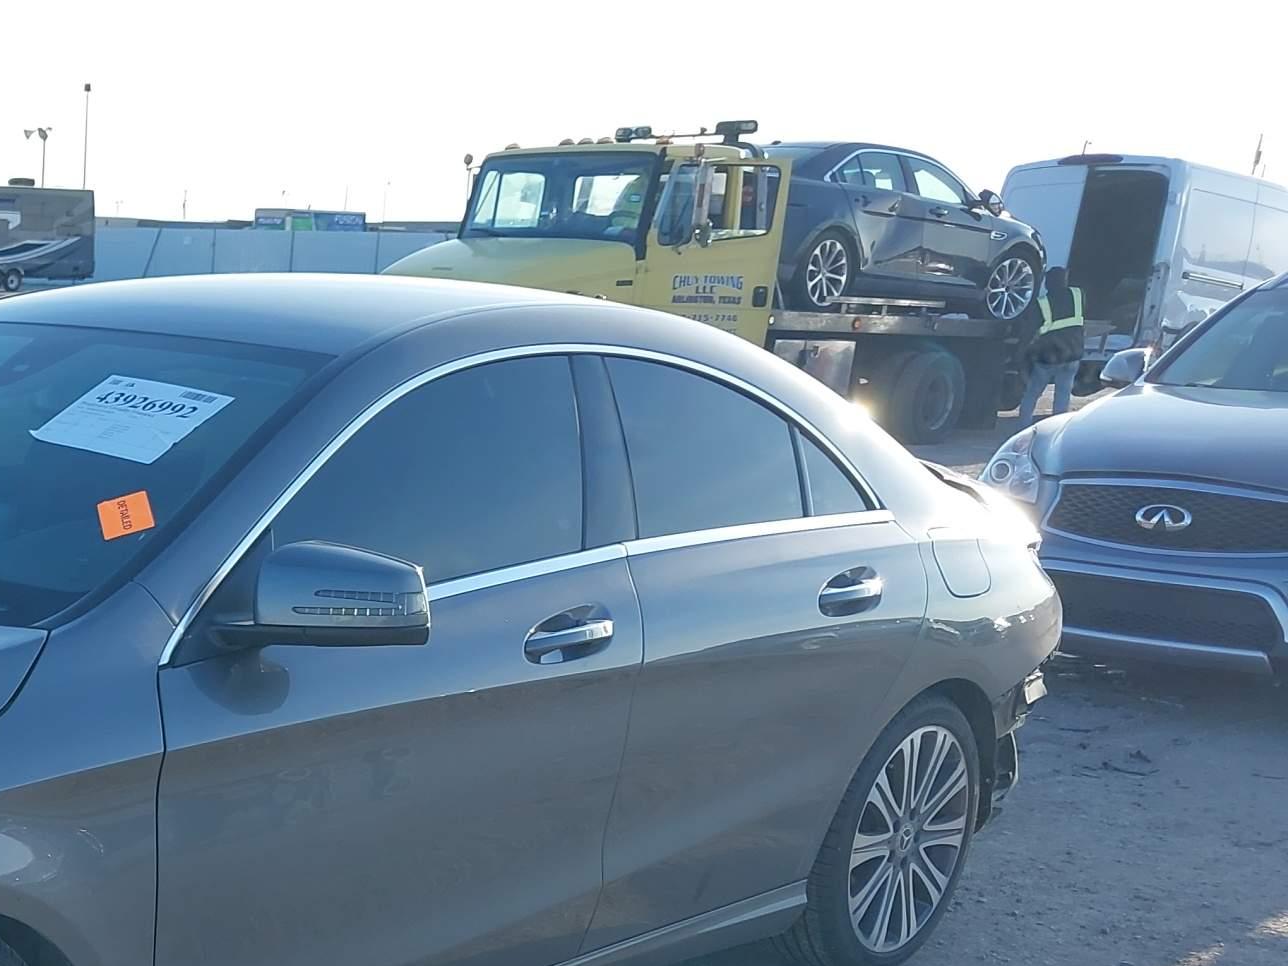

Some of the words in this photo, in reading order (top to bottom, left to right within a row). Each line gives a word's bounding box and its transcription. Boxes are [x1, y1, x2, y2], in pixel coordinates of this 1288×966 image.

[695, 285, 718, 294] LLC
[703, 275, 744, 290] TOWING
[718, 295, 742, 305] TEXAS
[96, 391, 199, 419] 43926992
[116, 500, 133, 530] DETAILED
